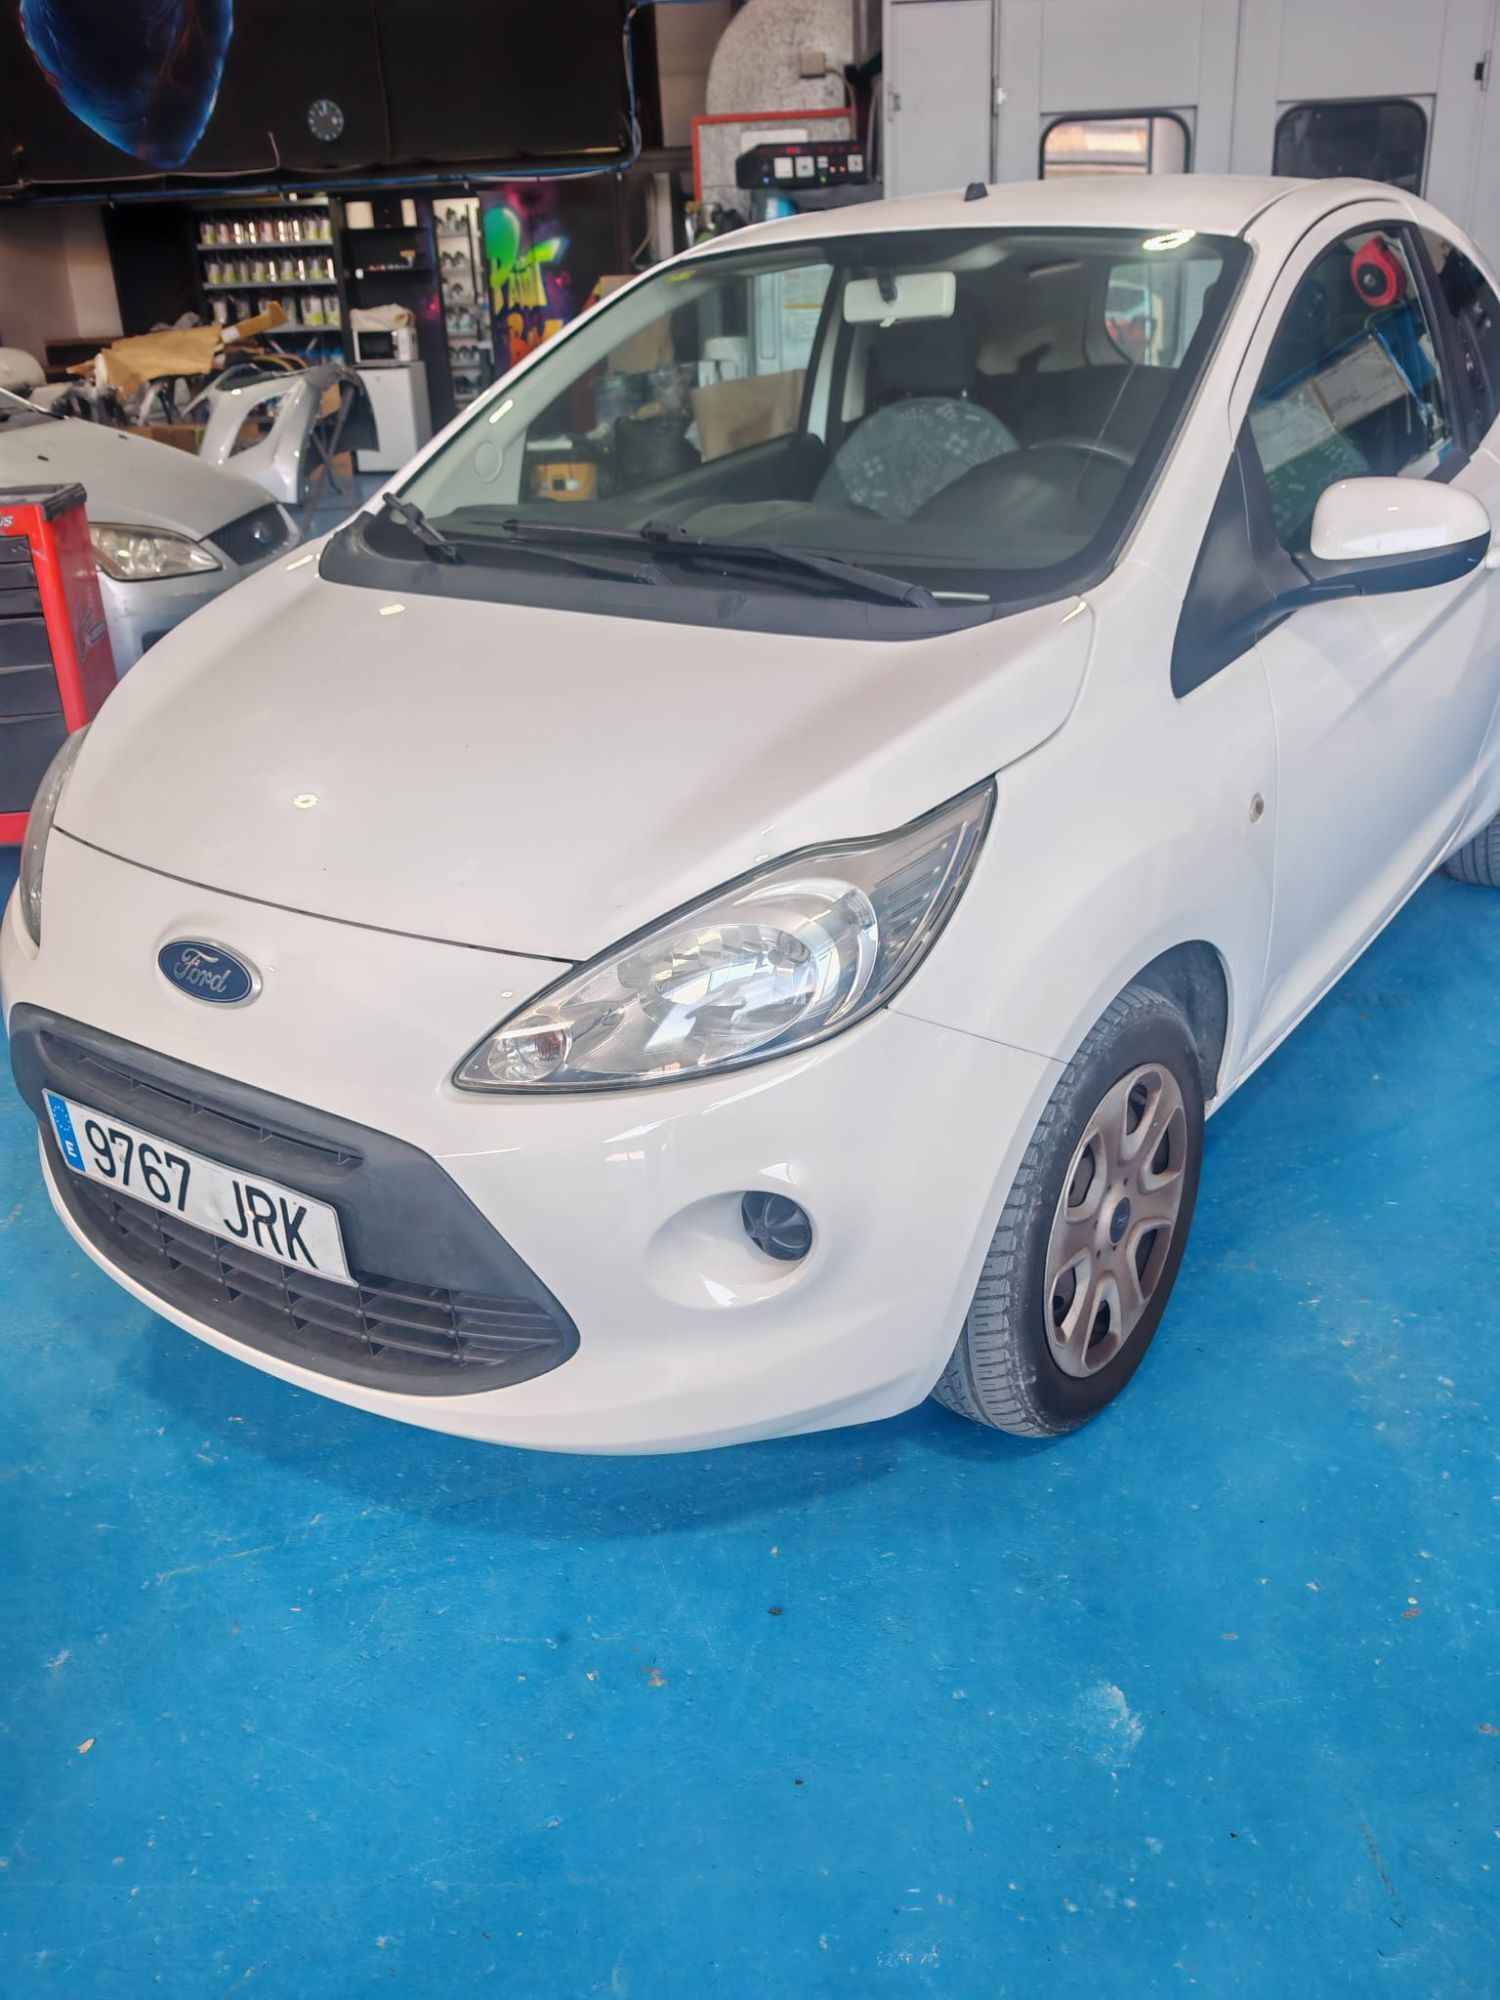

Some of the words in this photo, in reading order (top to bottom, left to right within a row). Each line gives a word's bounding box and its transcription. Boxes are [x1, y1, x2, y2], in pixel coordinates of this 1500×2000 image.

[173, 947, 232, 993] Ford
[65, 1140, 77, 1158] E
[84, 1119, 191, 1212] 9767
[223, 1180, 319, 1270] JRK
